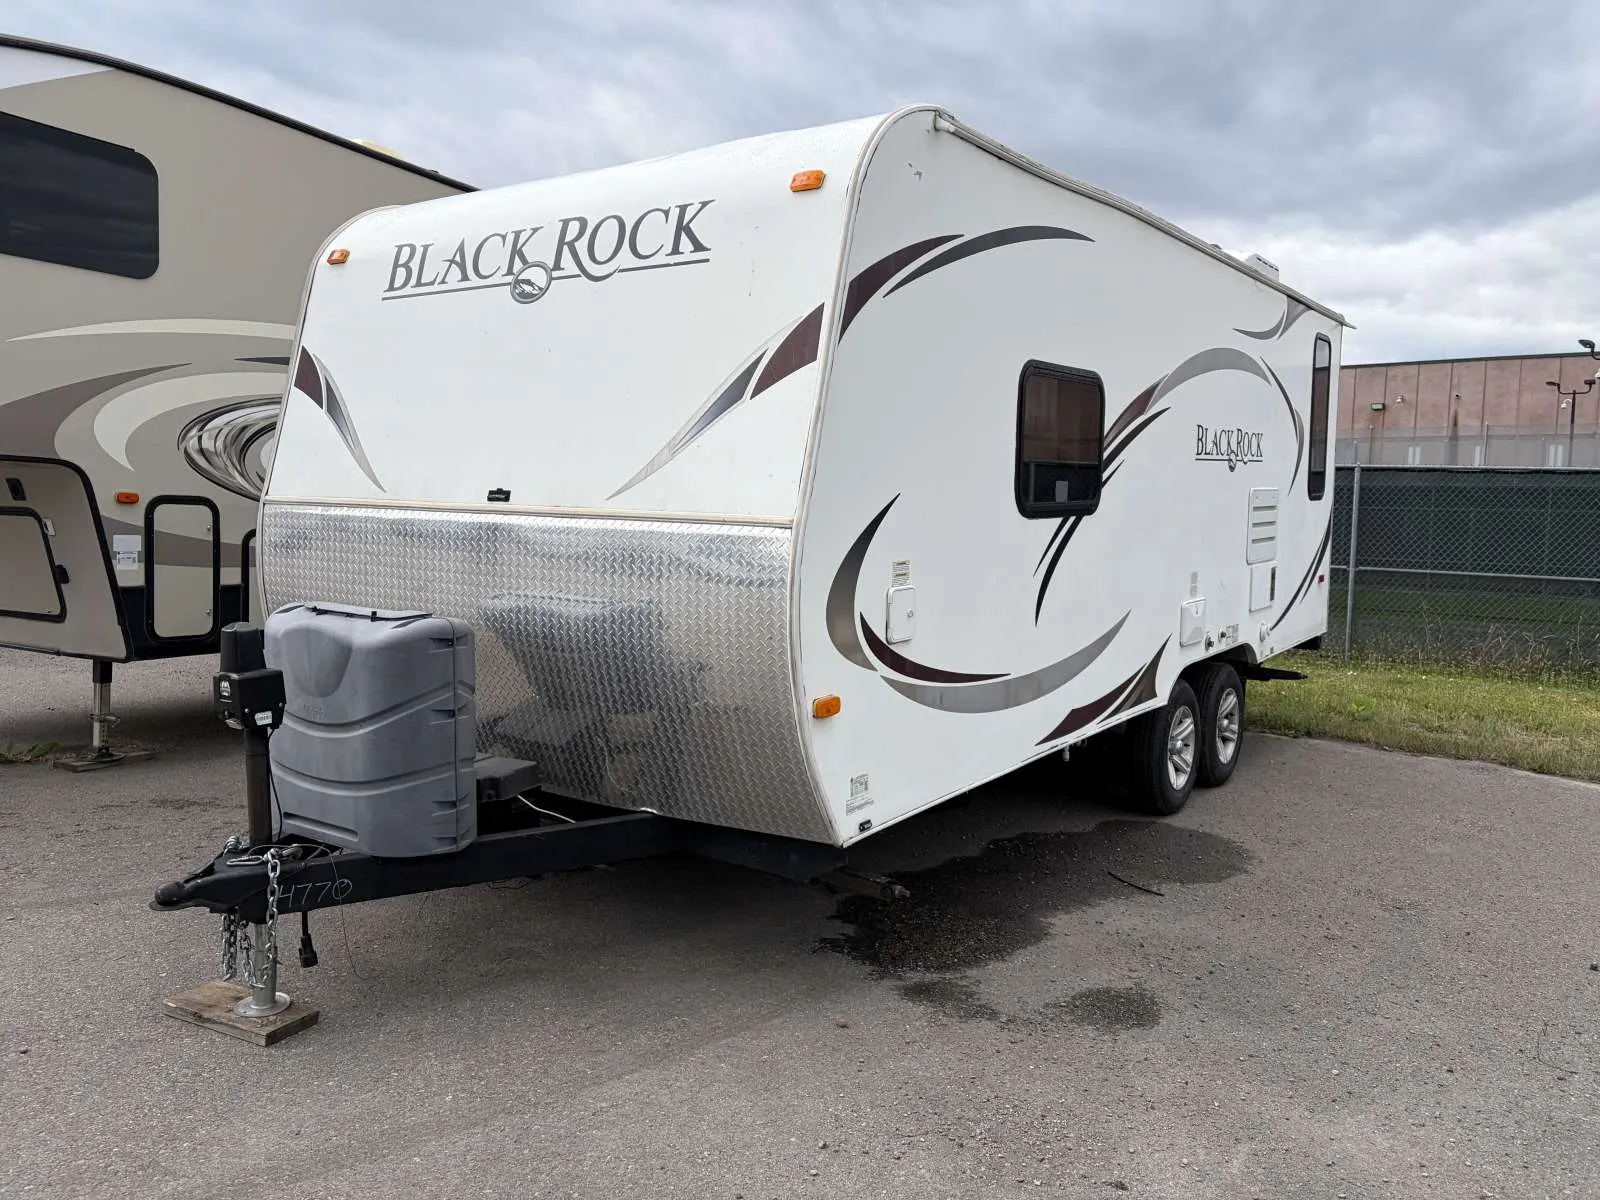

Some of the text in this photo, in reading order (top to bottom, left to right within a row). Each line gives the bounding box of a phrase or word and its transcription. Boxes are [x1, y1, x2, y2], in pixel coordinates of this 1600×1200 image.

[383, 199, 716, 293] BLACK ROCK
[1196, 424, 1263, 465] BLACK ROCK
